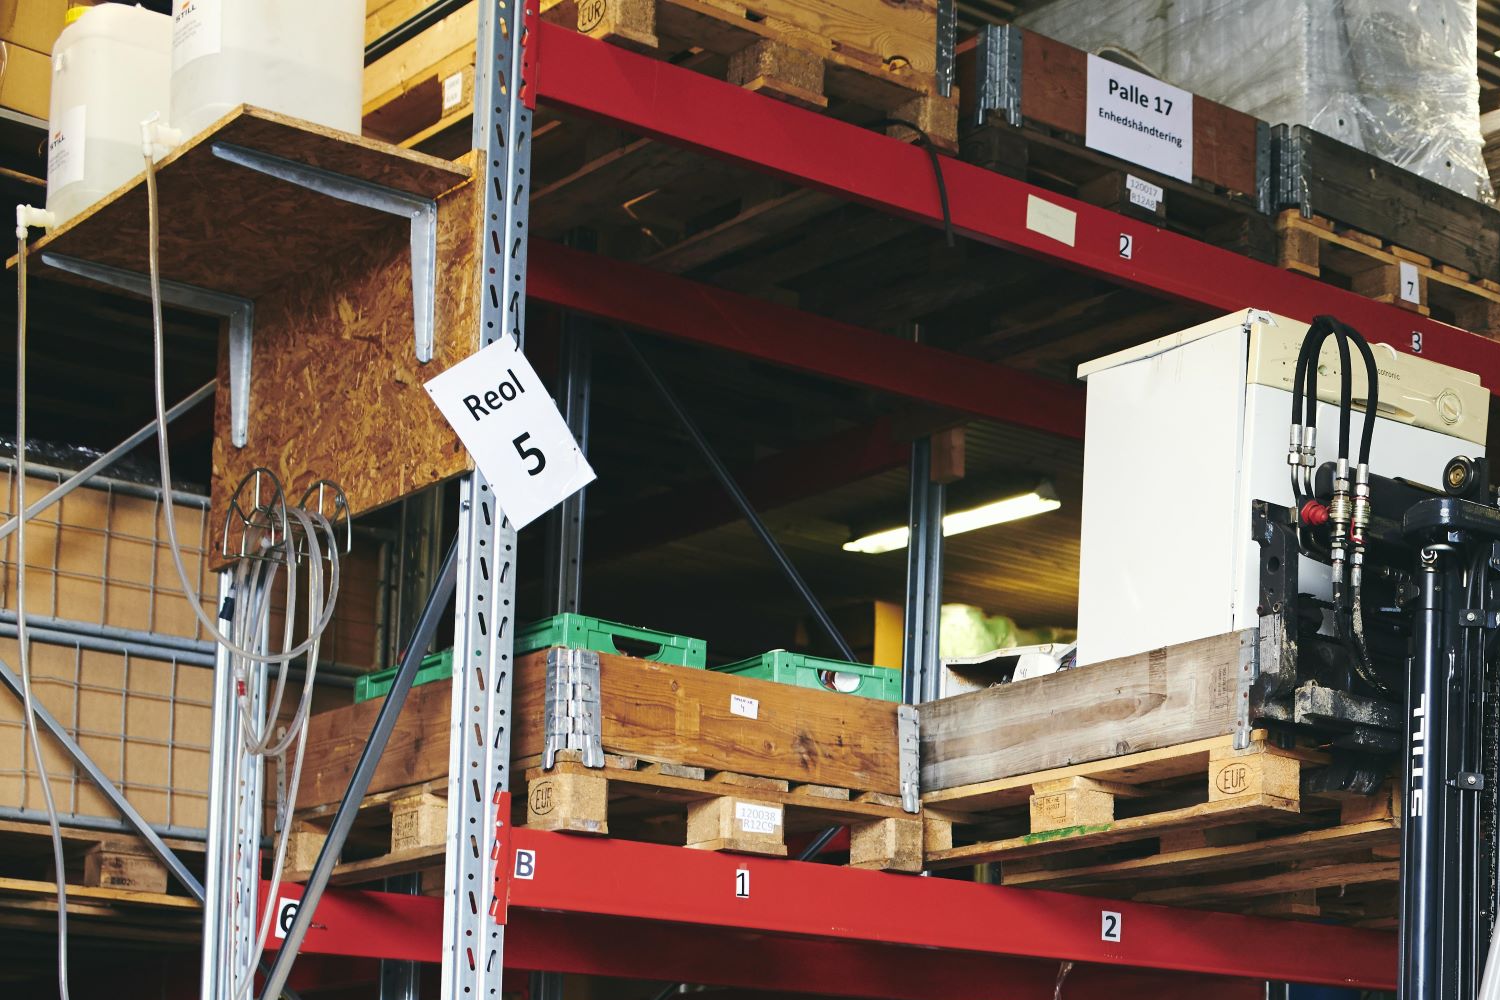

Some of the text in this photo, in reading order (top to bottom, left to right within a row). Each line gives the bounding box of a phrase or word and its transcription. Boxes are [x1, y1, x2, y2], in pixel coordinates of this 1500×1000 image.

[581, 0, 602, 27] EUR
[1108, 78, 1173, 116] Palle 17
[1098, 107, 1183, 149] Enhedshåndtering
[1130, 179, 1158, 197] 120017
[1120, 235, 1129, 258] 2
[1407, 281, 1414, 296] 7
[1411, 332, 1421, 352] 3
[462, 368, 526, 422] Reol
[512, 431, 547, 477] 5
[1410, 693, 1426, 817] STILL
[1223, 767, 1247, 790] EUR
[535, 787, 552, 810] EUR
[741, 807, 776, 822] 120038
[516, 850, 534, 877] B
[736, 871, 749, 897] 1
[1105, 915, 1117, 938] 2
